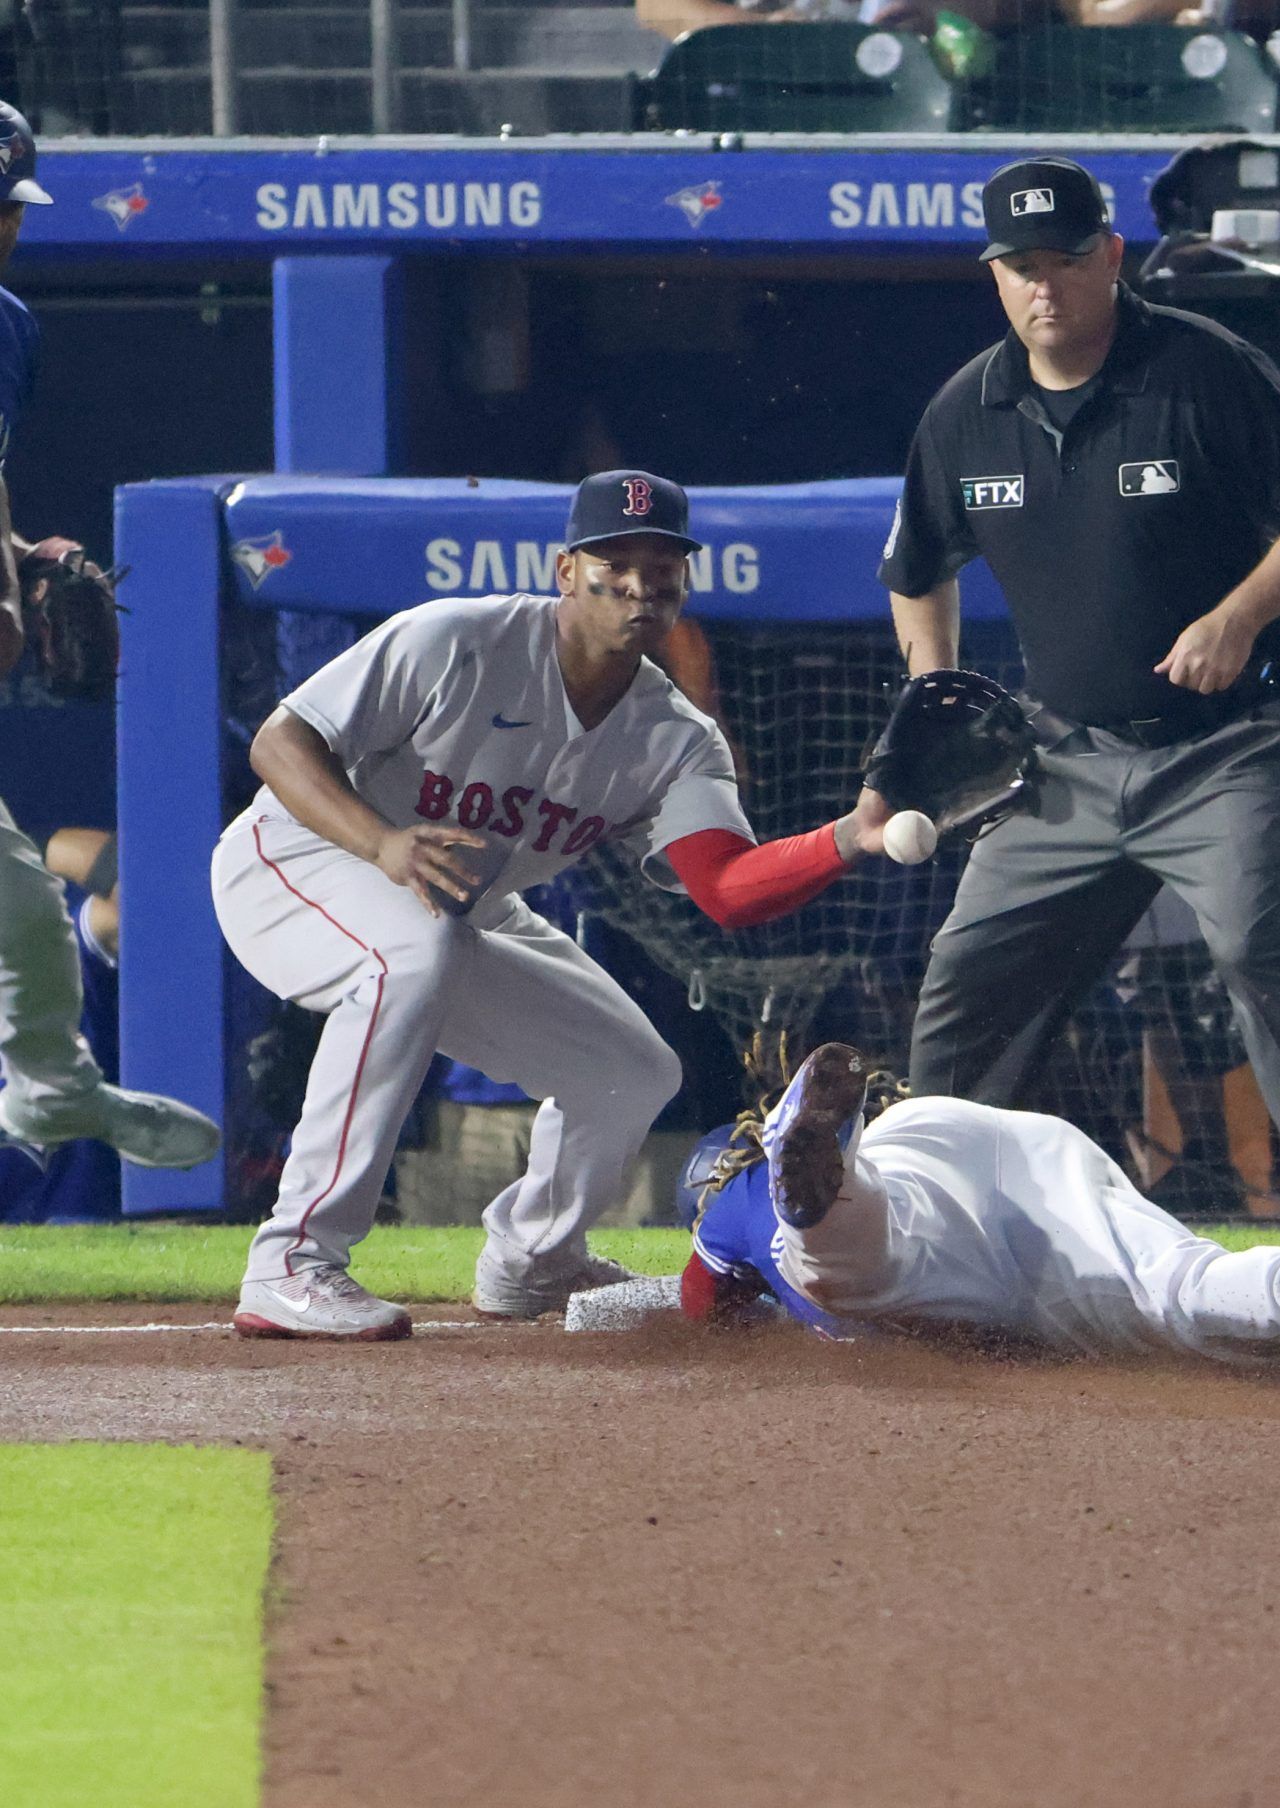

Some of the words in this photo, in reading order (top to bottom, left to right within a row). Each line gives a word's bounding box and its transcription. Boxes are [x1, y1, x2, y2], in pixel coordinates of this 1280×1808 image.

[255, 181, 541, 229] SAMSUNG
[622, 479, 654, 516] B
[974, 480, 1021, 505] FTX
[425, 538, 760, 593] SAMNG
[414, 769, 612, 857] BOSTO
